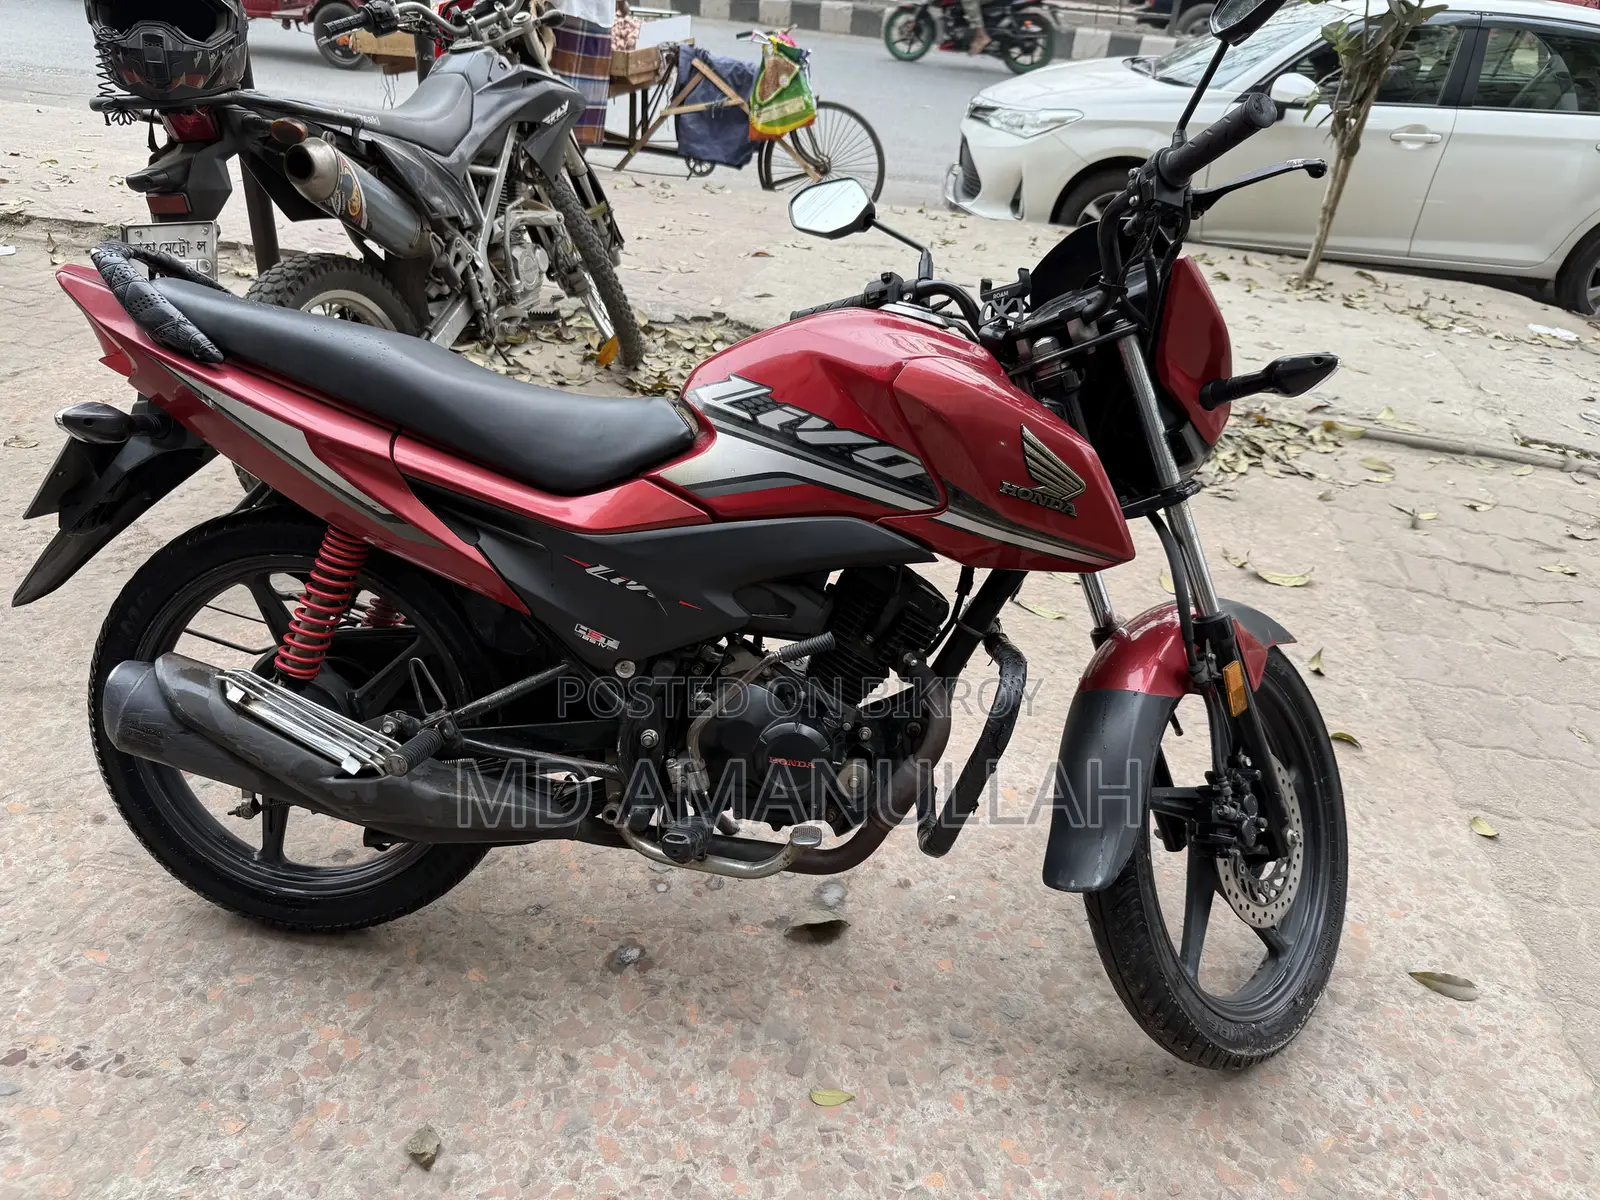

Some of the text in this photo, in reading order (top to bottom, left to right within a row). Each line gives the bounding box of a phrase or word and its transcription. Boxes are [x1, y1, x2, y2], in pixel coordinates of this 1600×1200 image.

[992, 290, 1009, 300] ROAM
[998, 480, 1078, 517] HONDA
[768, 756, 816, 769] HONDA
